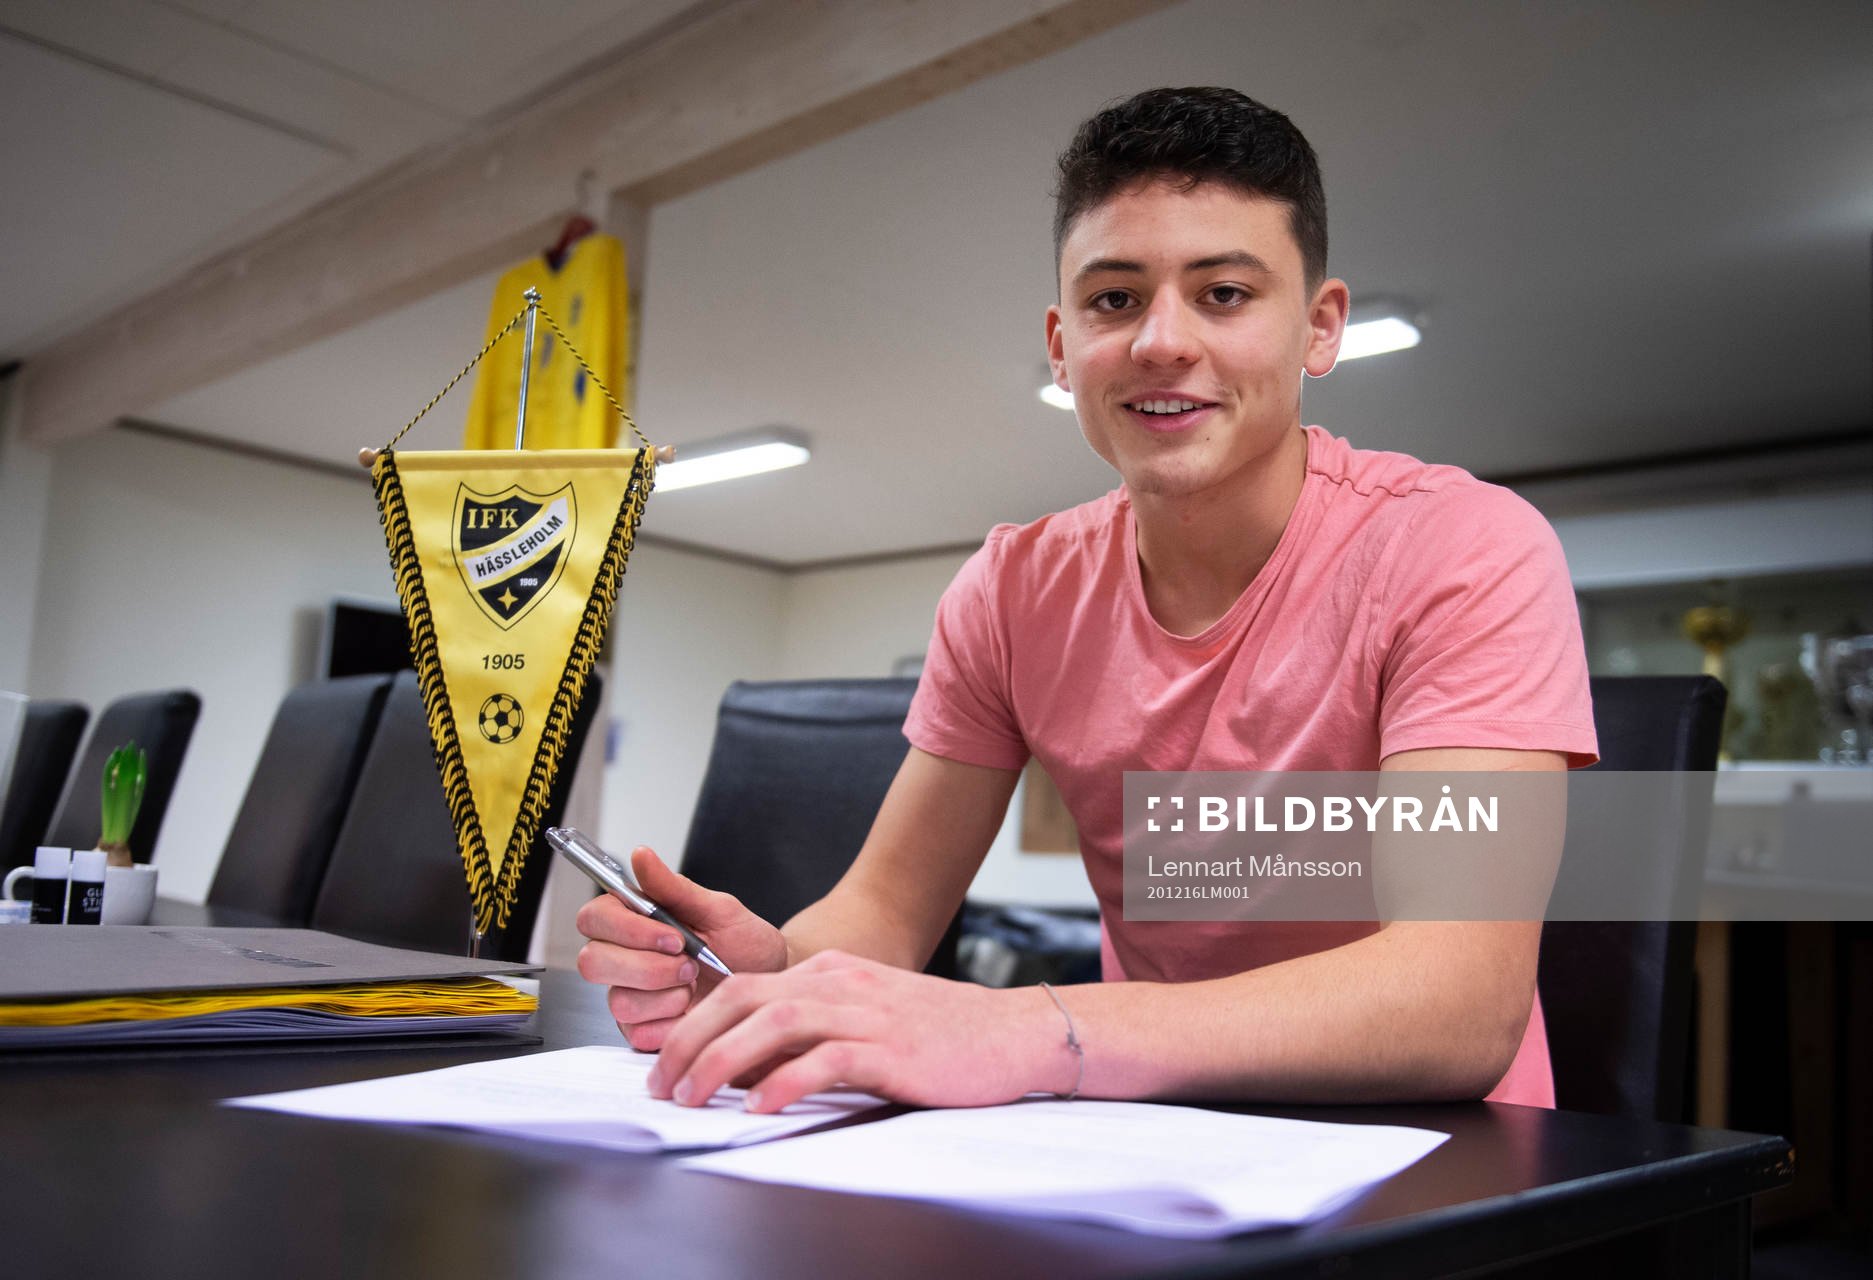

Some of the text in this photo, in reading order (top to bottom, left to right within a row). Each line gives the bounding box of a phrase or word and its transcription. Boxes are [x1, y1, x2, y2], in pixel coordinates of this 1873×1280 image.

[466, 507, 520, 529] IFK
[475, 515, 564, 578] HÄSSLEHOLM
[519, 577, 538, 587] 1905
[481, 653, 525, 670] 1905
